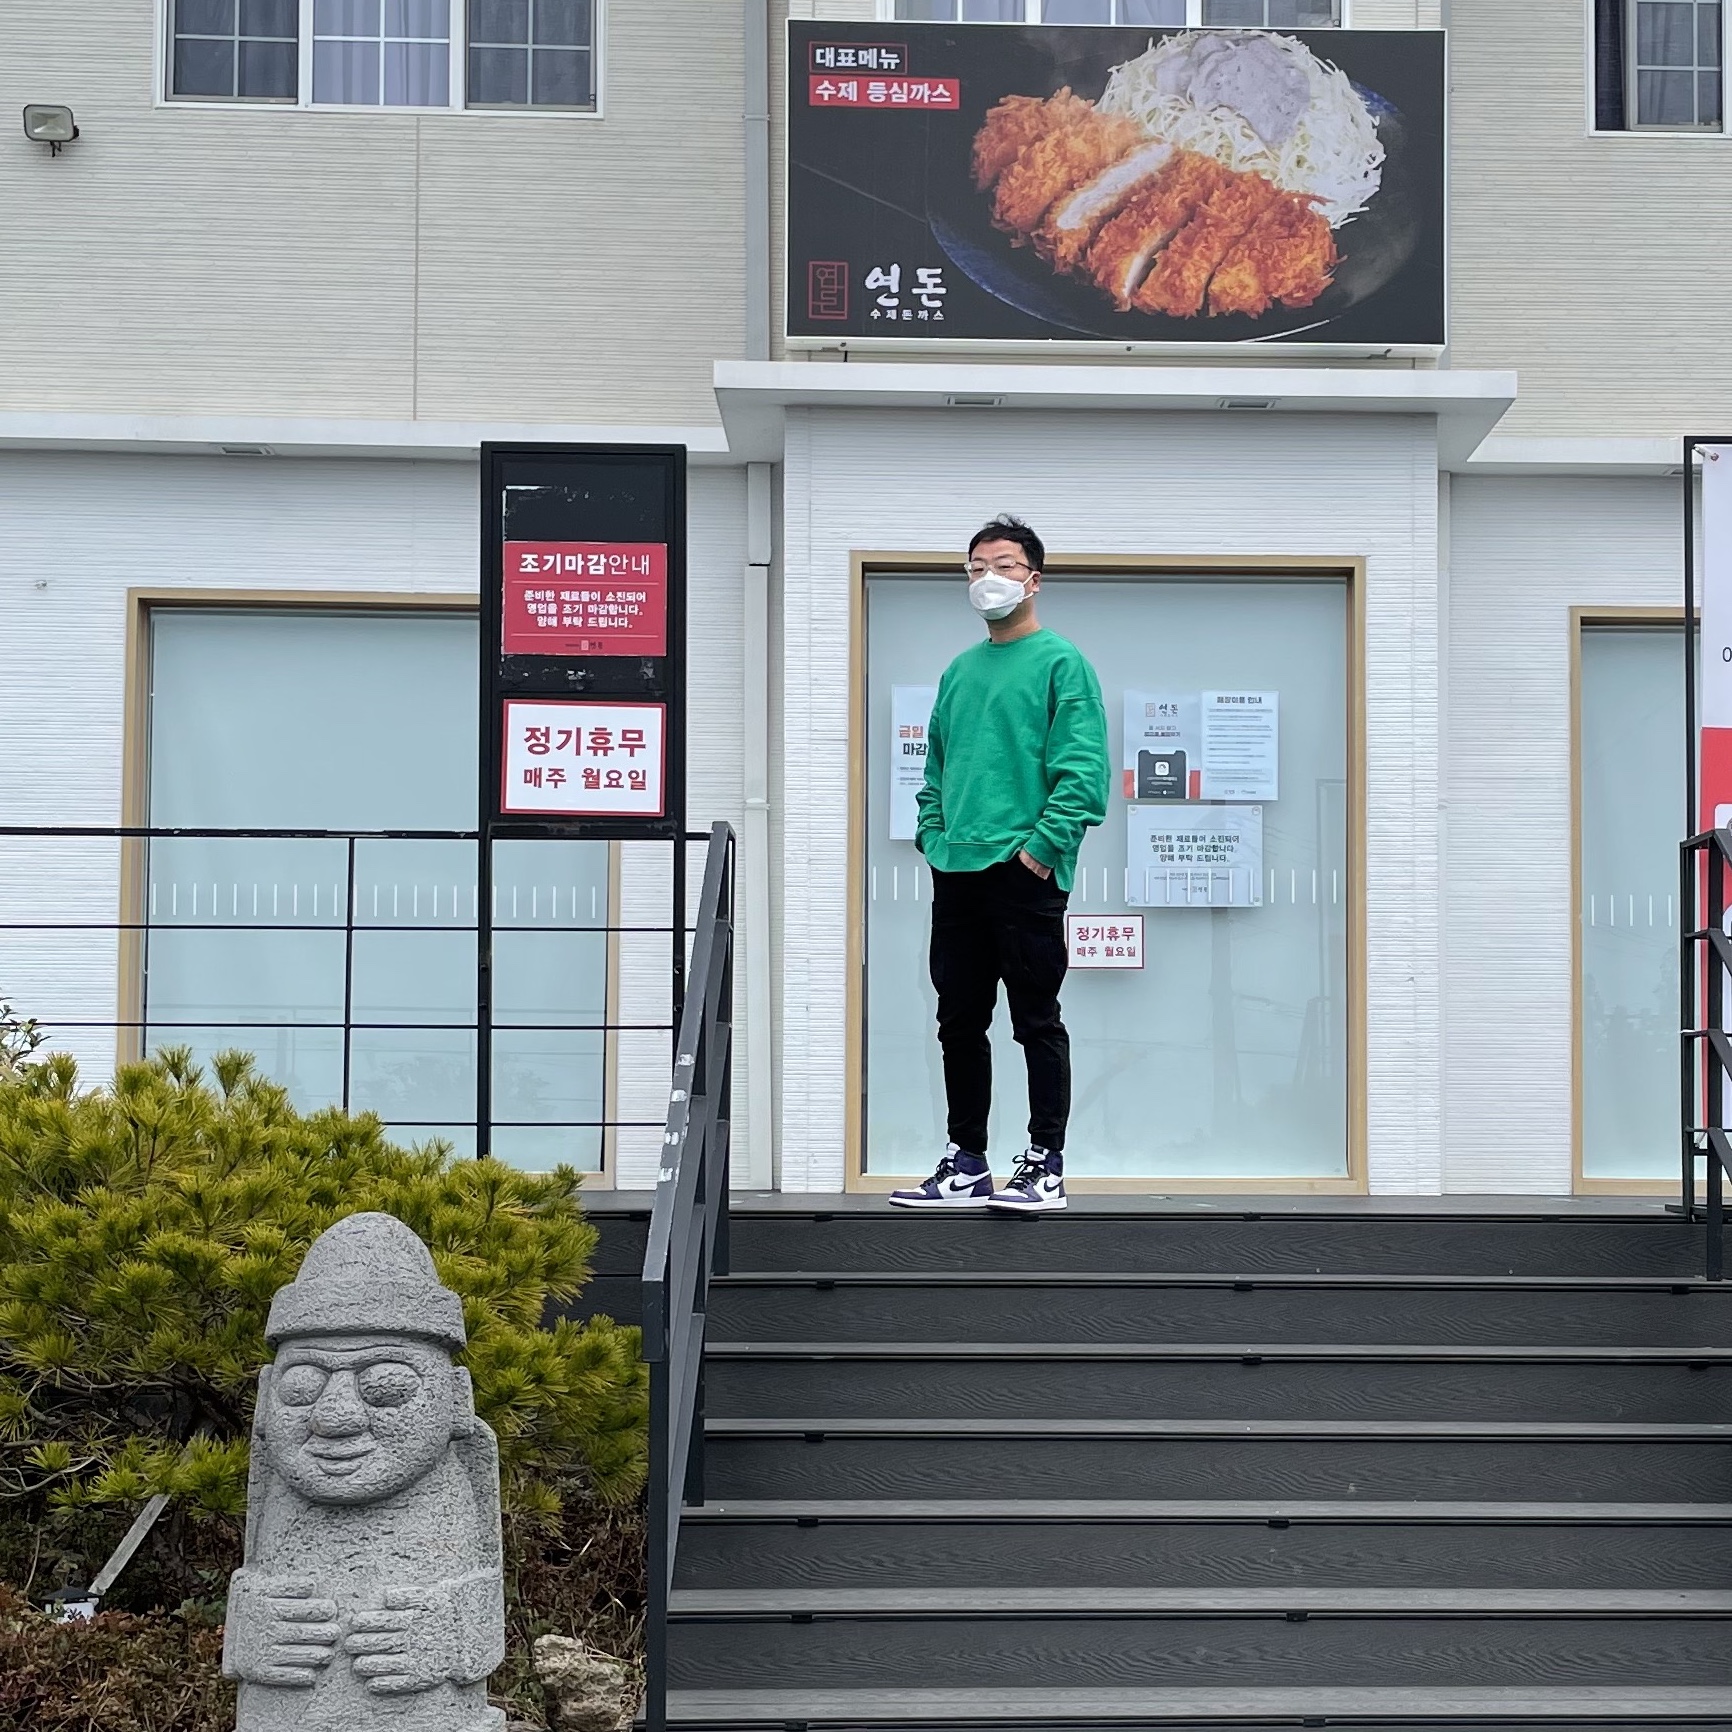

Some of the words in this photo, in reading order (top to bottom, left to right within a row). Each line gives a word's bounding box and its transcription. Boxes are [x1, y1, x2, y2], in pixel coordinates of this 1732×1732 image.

[815, 46, 901, 70] 대표메뉴
[815, 80, 858, 102] 수제
[866, 82, 952, 104] 등심까스
[519, 553, 650, 576] 조기마감안내
[524, 590, 555, 602] 준비한
[560, 590, 600, 602] 재료들이
[605, 591, 646, 602] 소진되어
[527, 603, 557, 614] 영업을
[562, 604, 582, 614] 조기
[588, 604, 643, 616] 마감합니다.
[536, 616, 558, 628] 양해
[562, 616, 582, 628] 부탁
[588, 616, 633, 628] 드립니다.
[898, 724, 924, 738] 금일
[524, 726, 647, 758] 정기휴무
[523, 767, 567, 789] 매주
[581, 767, 648, 791] 월요일
[1178, 844, 1193, 852] 조기
[1178, 854, 1193, 862] 부탁
[1076, 926, 1136, 942] 정기휴무
[1076, 946, 1098, 958] 매주
[1104, 946, 1136, 958] 월요일
